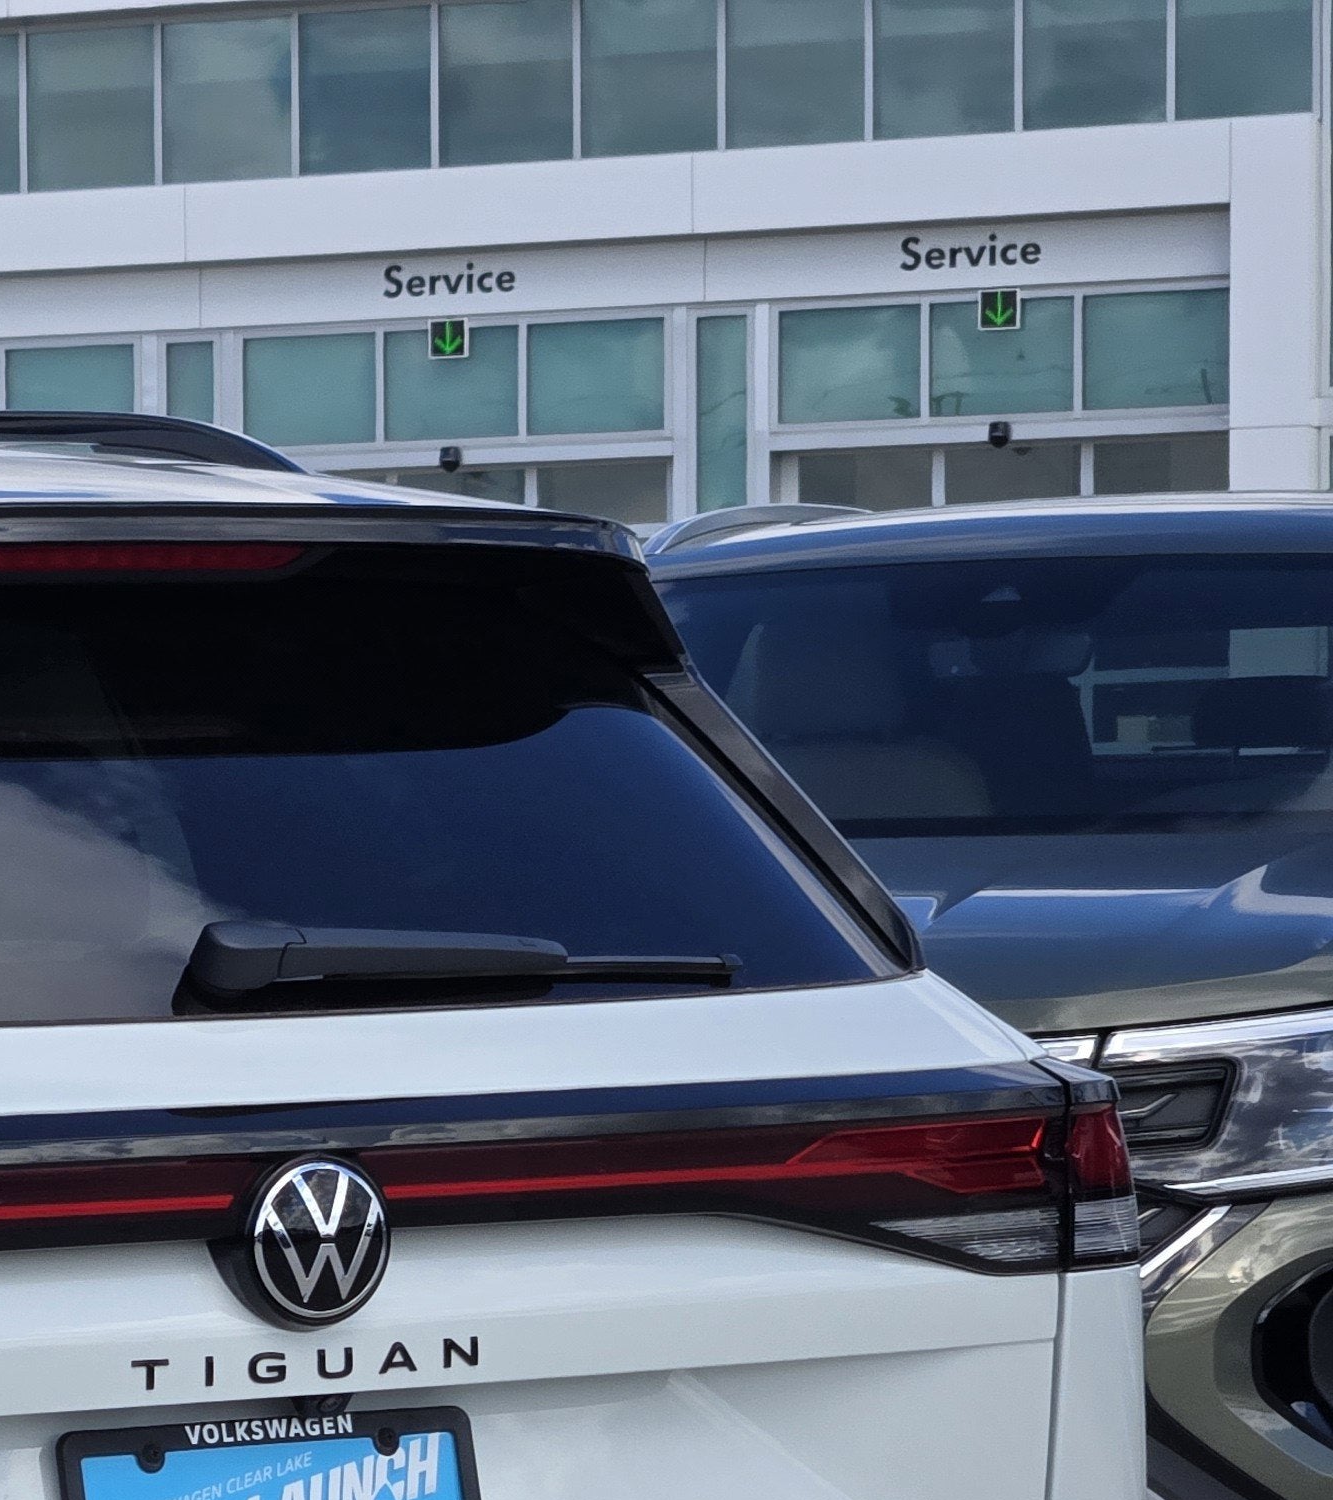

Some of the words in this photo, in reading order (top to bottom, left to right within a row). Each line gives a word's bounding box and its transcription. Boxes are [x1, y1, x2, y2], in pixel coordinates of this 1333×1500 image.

[899, 233, 1042, 272] Service
[383, 262, 516, 299] Service
[131, 1336, 480, 1391] TIGUAN
[184, 1414, 354, 1445] VOLKSWAGEN
[225, 1465, 274, 1496] CLEAR
[276, 1451, 313, 1478] LAKE
